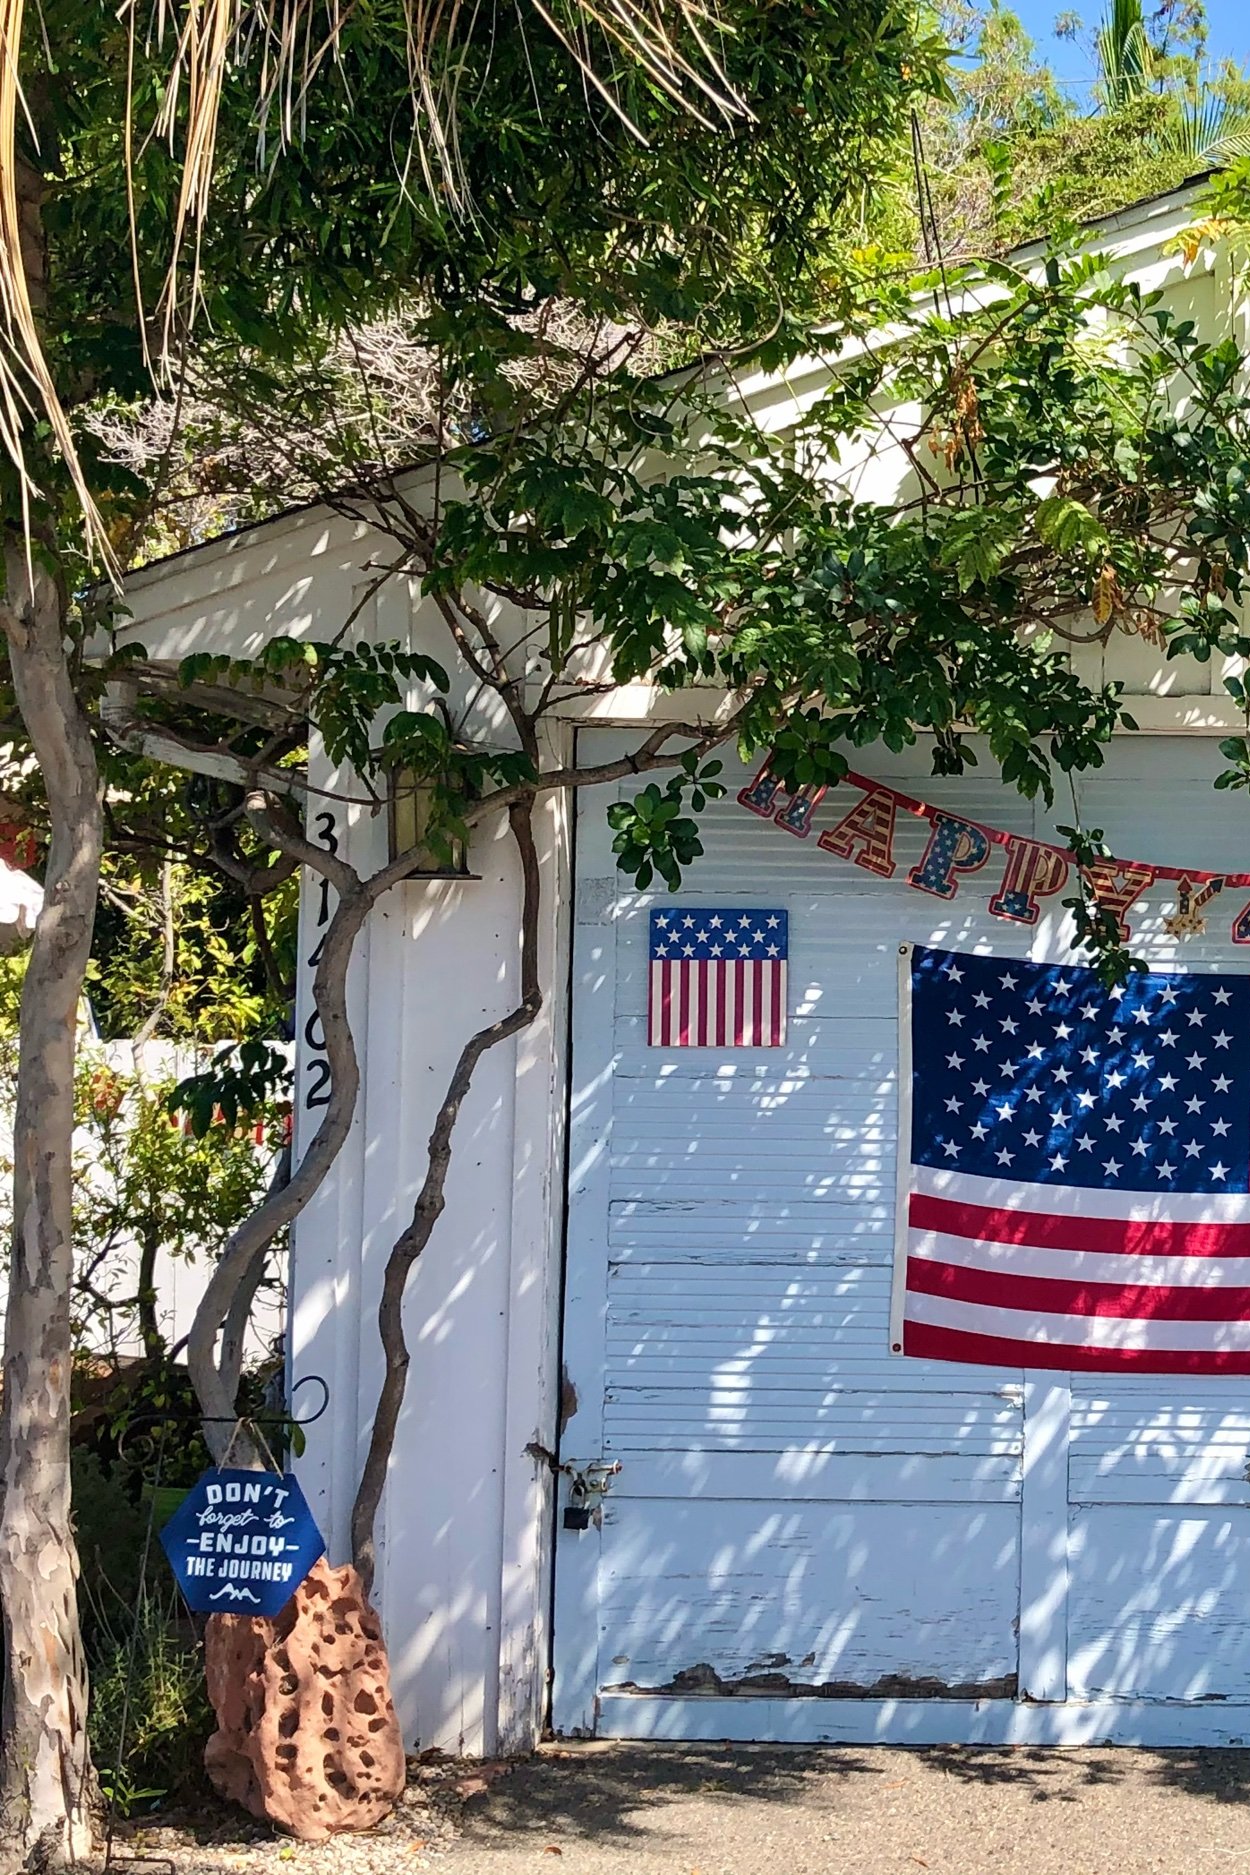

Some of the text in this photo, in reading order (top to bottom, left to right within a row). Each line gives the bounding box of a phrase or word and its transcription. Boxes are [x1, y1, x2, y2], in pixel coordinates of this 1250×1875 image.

[737, 750, 1155, 942] HAPPY
[206, 1483, 289, 1508] DON'T
[196, 1506, 295, 1532] forget to
[186, 1556, 293, 1582] THE JOURNEY
